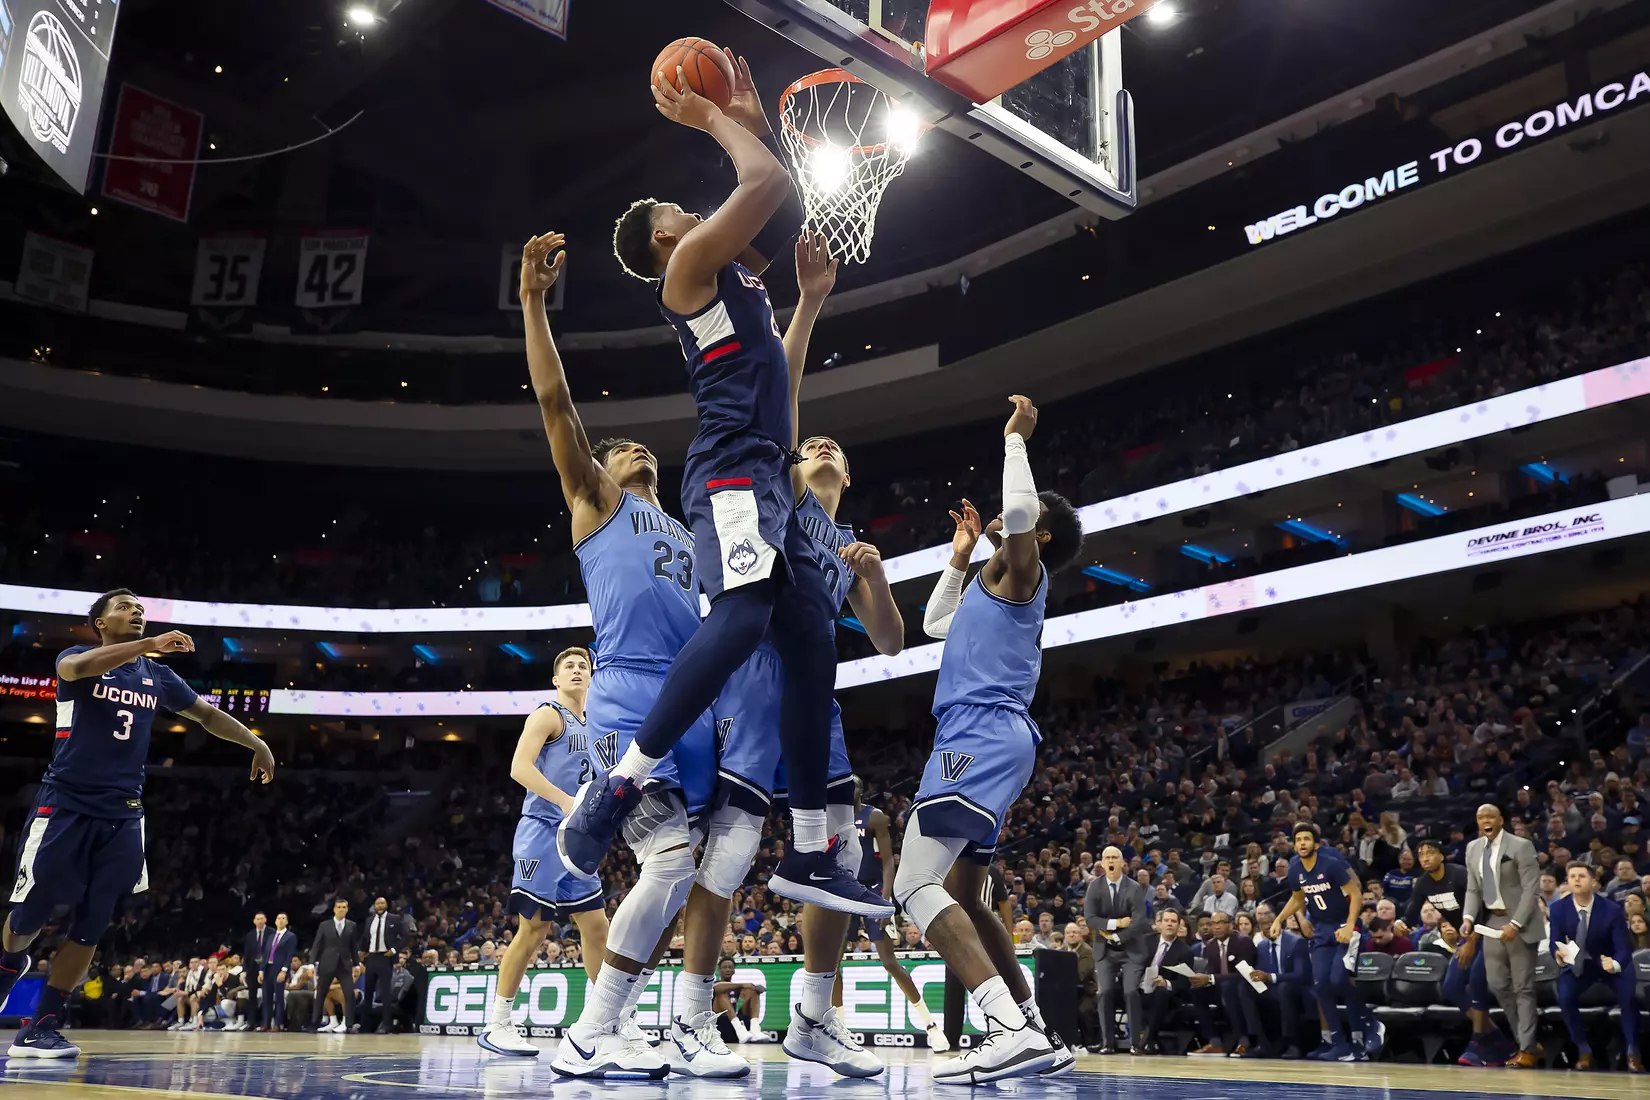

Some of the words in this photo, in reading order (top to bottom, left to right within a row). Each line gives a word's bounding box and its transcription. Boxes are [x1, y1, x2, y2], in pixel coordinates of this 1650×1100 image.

[1244, 161, 1420, 245] WELCOME
[1430, 138, 1482, 173] TO
[1495, 72, 1650, 149] COMCA
[201, 254, 250, 301] 35
[304, 253, 357, 303] 42
[1467, 529, 1520, 548] DEVINE
[1572, 513, 1603, 526] INC.
[653, 540, 694, 592] 23
[9, 687, 37, 699] Fargo
[21, 676, 38, 686] List
[39, 678, 51, 687] of
[92, 683, 158, 710] UCONN
[112, 709, 134, 741] 3
[593, 730, 619, 772] V
[941, 751, 975, 782] V
[518, 858, 541, 881] V
[1313, 894, 1328, 910] 0
[419, 1025, 440, 1035] GEICO
[446, 1025, 469, 1036] GEICO
[530, 1027, 556, 1038] GEICO
[874, 1034, 914, 1047] GEICO
